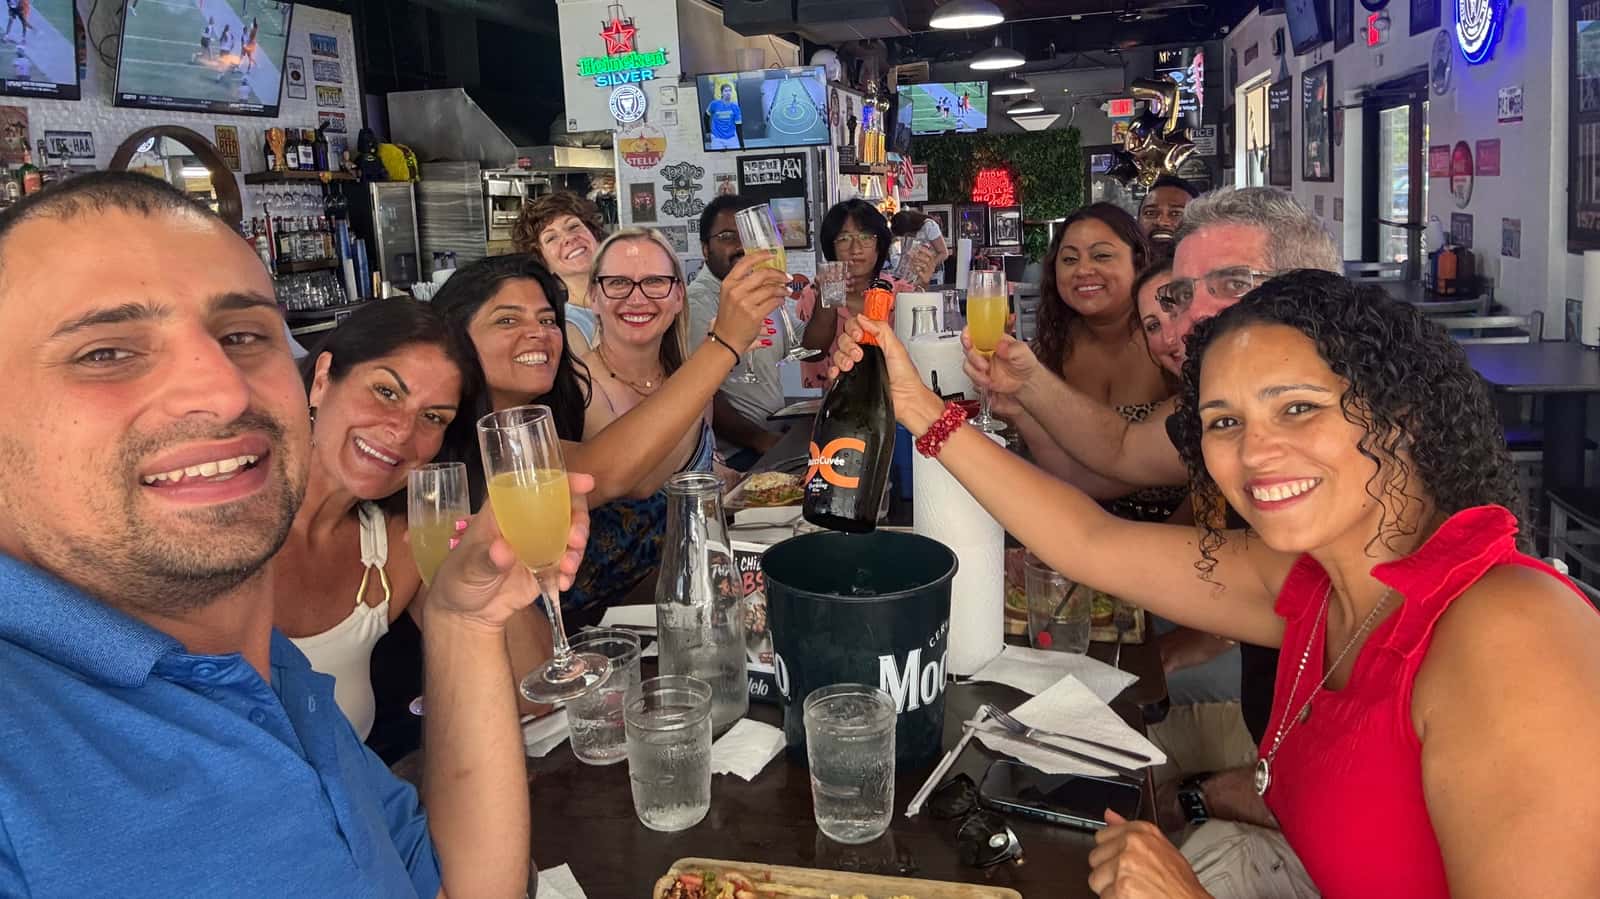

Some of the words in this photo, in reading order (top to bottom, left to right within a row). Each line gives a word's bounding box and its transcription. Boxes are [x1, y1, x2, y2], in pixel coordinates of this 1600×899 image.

[579, 49, 667, 77] Heineken
[595, 68, 655, 88] SILVER
[626, 155, 661, 166] STELLA
